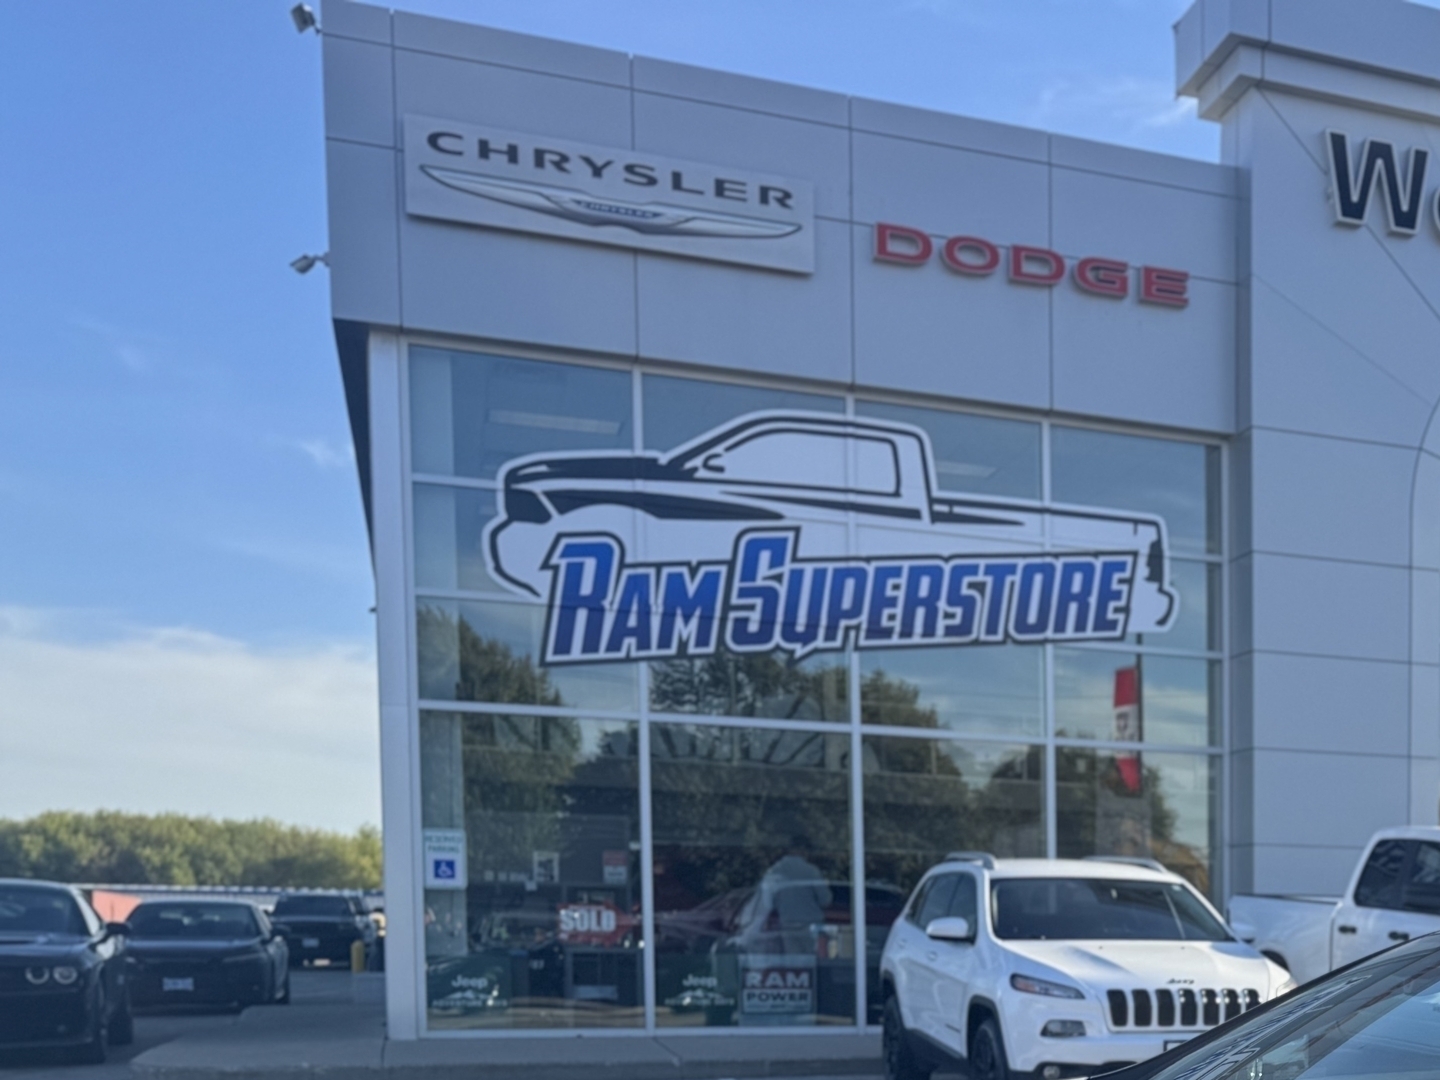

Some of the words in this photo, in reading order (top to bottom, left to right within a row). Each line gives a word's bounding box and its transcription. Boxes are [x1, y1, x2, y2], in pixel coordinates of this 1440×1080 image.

[427, 130, 794, 210] CHRYSLER
[873, 222, 1190, 308] DODGE
[560, 908, 616, 932] SOLD
[451, 974, 488, 989] Jeep
[682, 974, 718, 989] Jeep
[745, 971, 810, 988] RAM
[746, 992, 810, 1002] POWER
